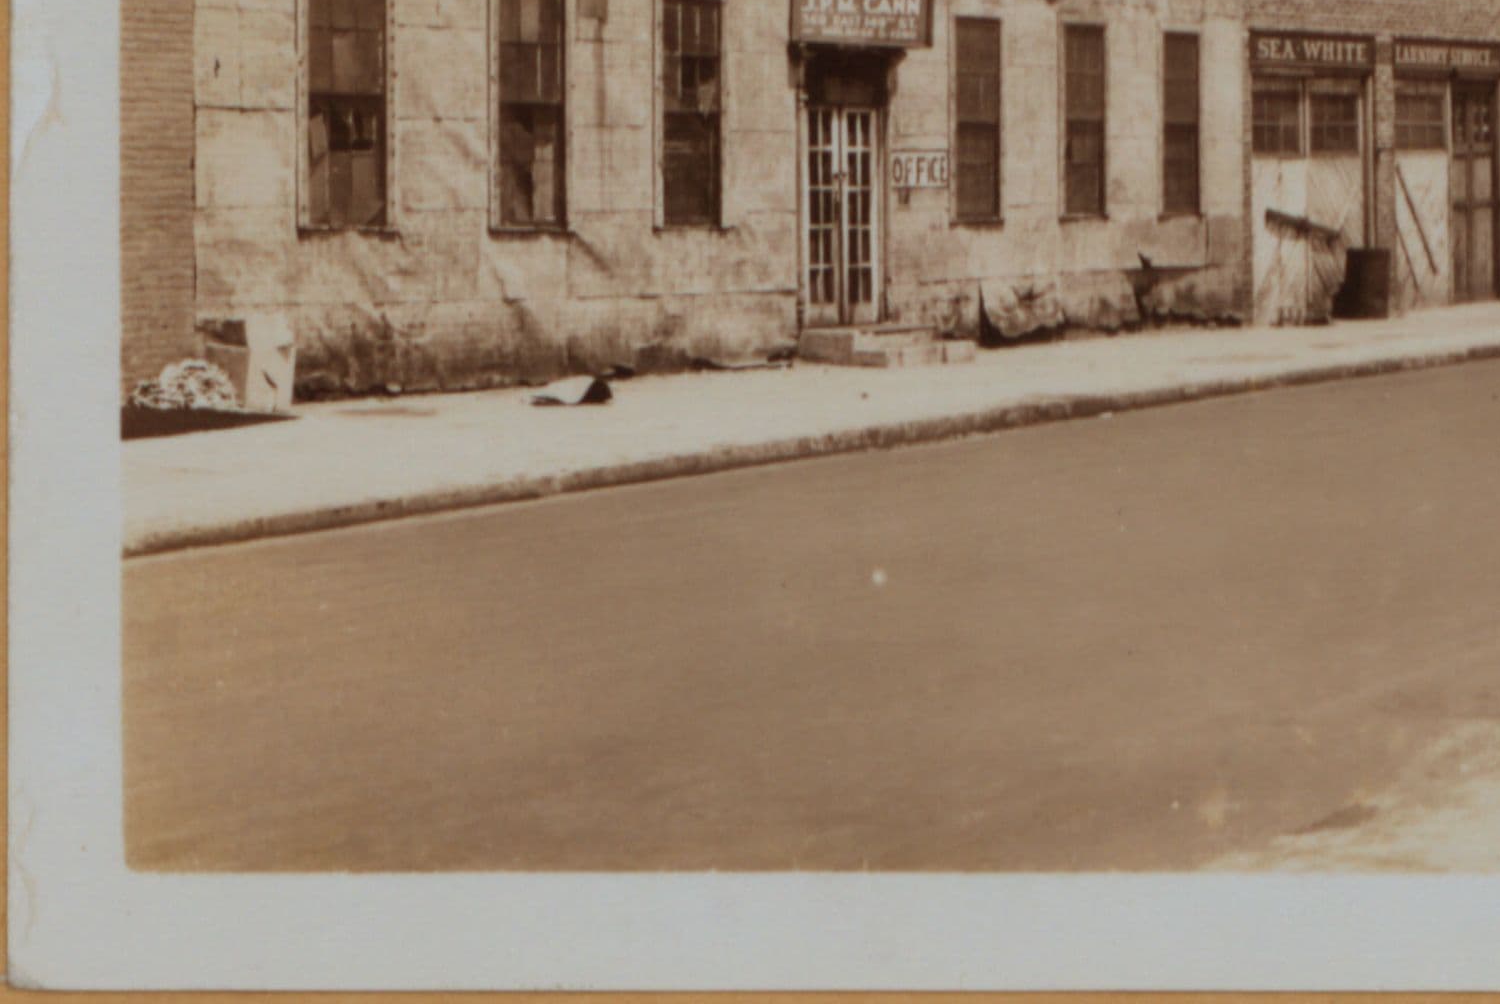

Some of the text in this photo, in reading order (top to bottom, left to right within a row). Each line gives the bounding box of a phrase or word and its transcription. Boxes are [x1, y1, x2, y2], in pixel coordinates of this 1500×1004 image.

[1257, 37, 1367, 63] SEA WHITE
[892, 155, 948, 184] OFFICE
